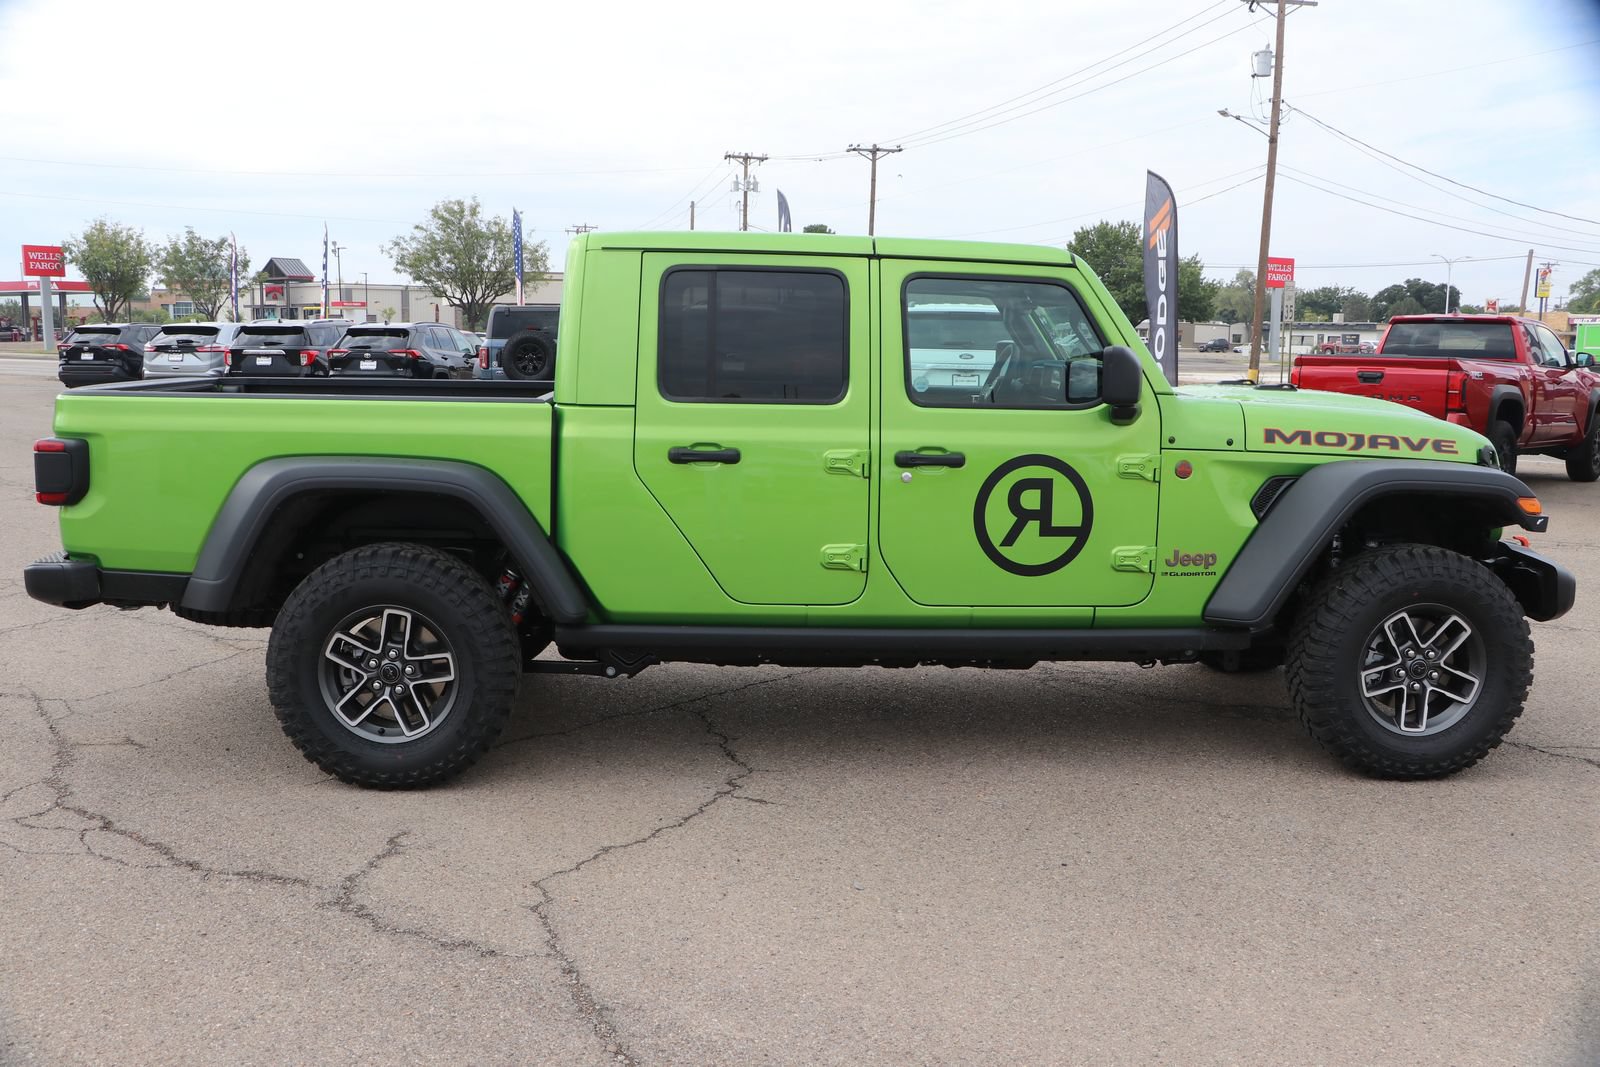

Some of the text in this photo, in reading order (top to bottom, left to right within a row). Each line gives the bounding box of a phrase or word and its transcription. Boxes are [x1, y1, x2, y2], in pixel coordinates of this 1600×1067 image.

[28, 252, 61, 260] WELLS
[29, 262, 62, 270] FARGO
[1268, 264, 1292, 272] WELLS
[1268, 273, 1292, 281] FARGO
[1154, 228, 1167, 374] ODGE
[1285, 304, 1294, 320] 35
[1264, 428, 1459, 455] MOJAVE
[1165, 549, 1217, 569] Jeep
